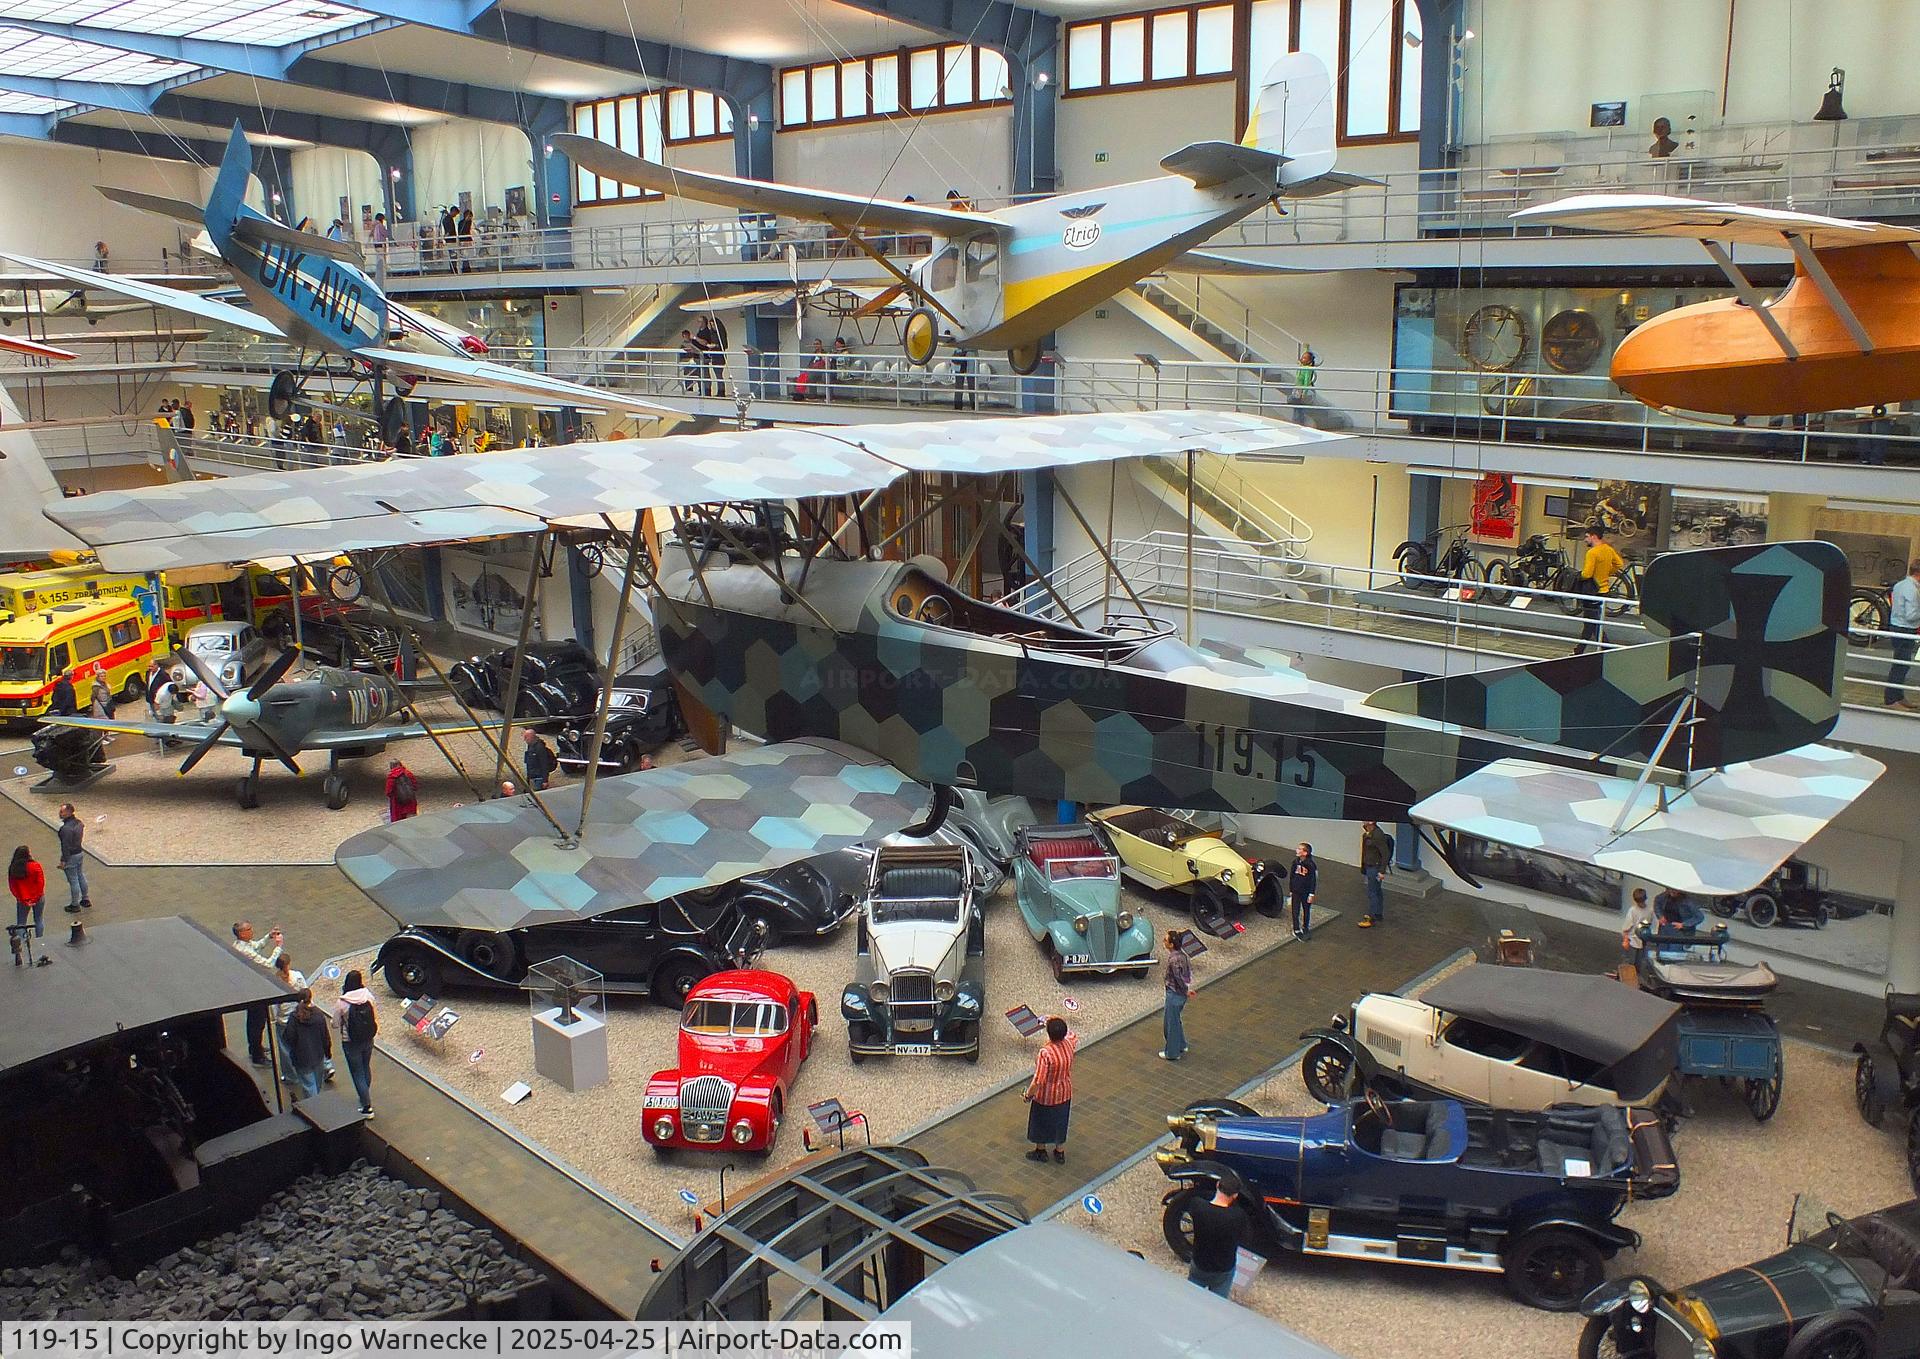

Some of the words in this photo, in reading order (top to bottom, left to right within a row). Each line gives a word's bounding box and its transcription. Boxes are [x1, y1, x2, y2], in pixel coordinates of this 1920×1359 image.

[49, 591, 70, 603] 155
[1195, 720, 1316, 788] 119.15
[897, 1046, 929, 1054] NV-417
